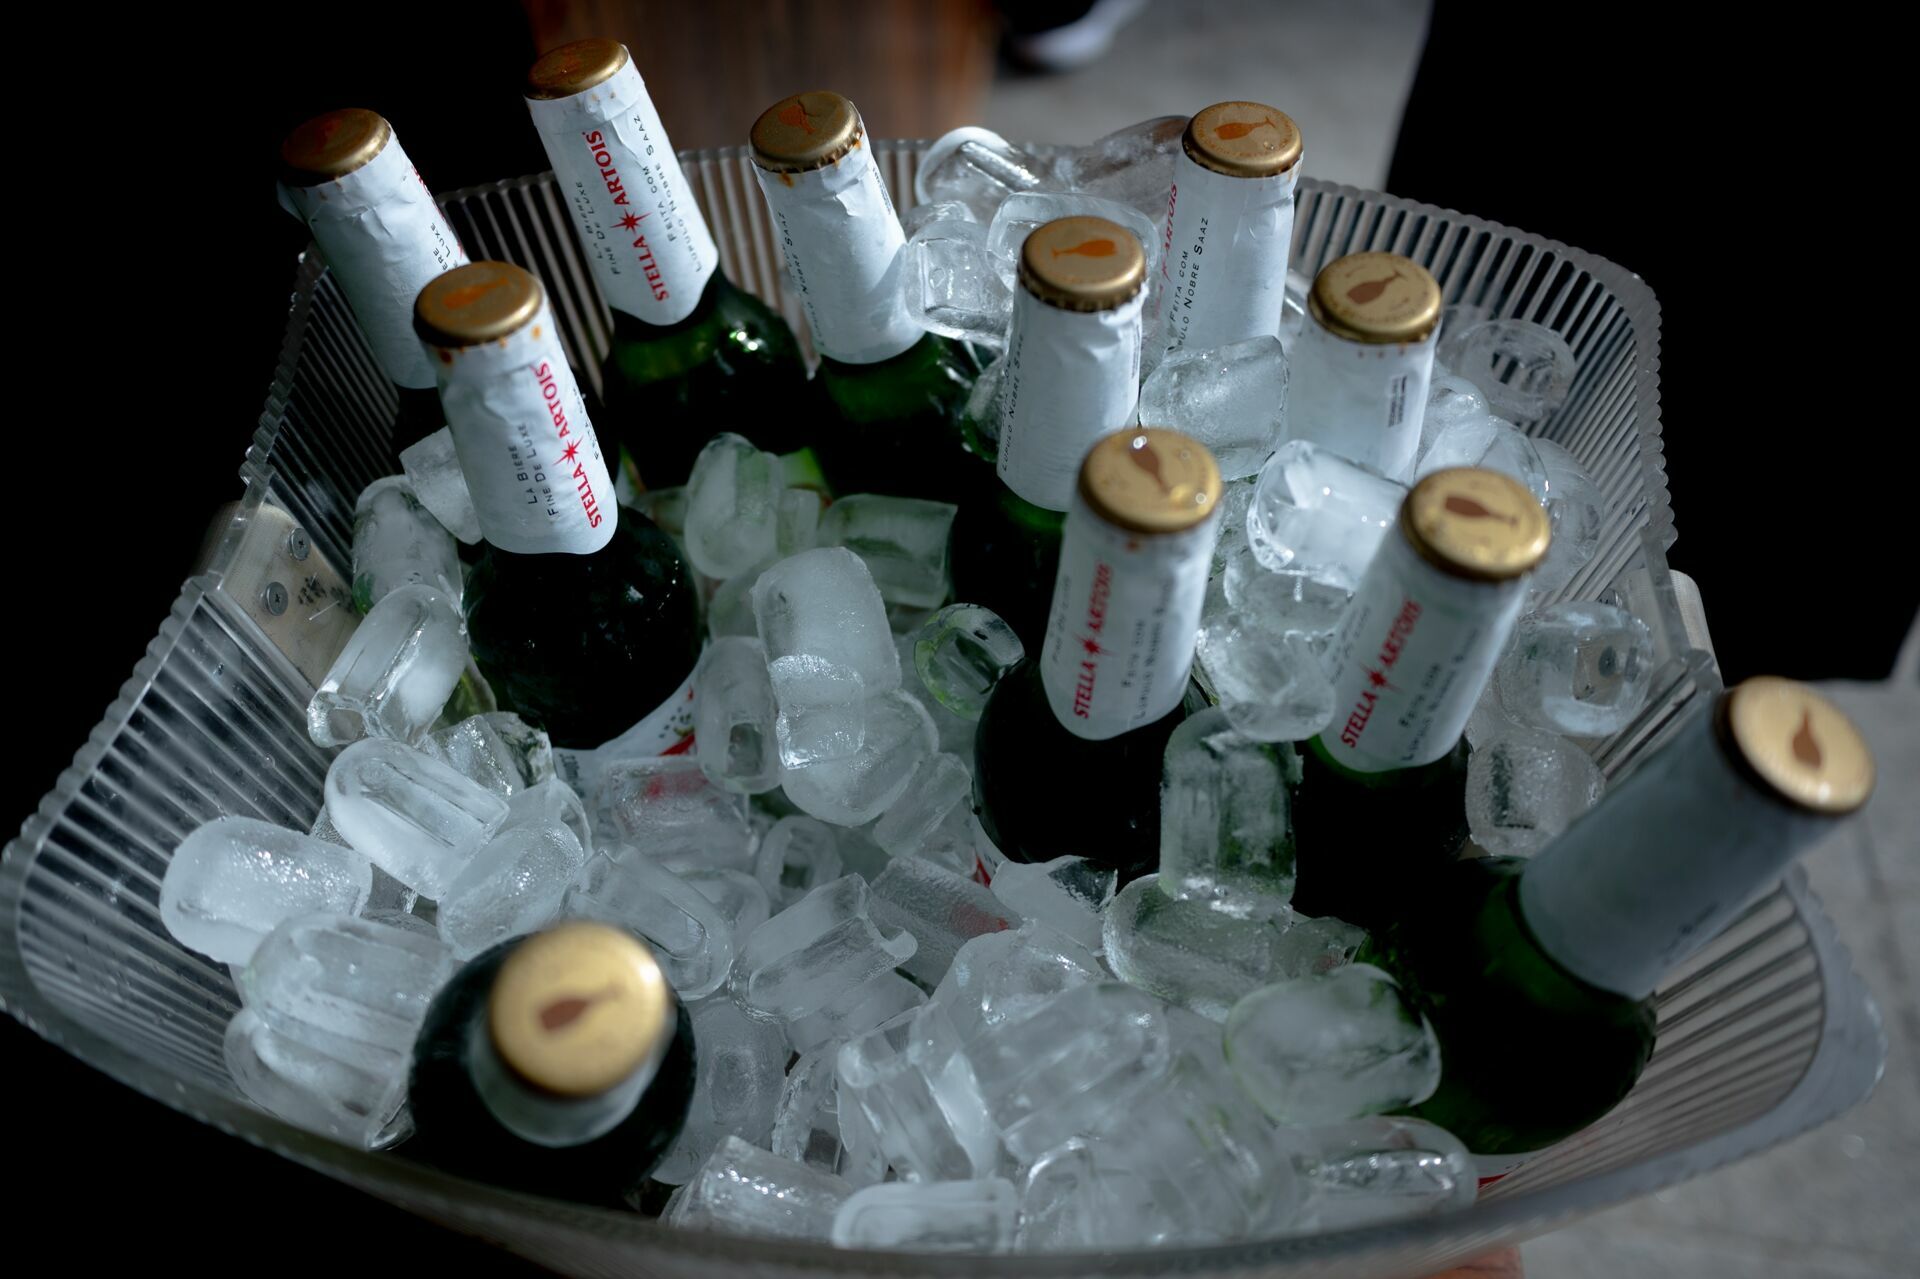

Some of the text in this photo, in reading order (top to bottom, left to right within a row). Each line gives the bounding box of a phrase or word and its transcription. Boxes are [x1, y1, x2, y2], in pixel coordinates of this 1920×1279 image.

[633, 114, 656, 157] SAAZ
[430, 222, 451, 258] LUXE
[576, 181, 622, 276] FINE DE LUXE
[583, 129, 670, 302] STELLA ARTOIS
[642, 165, 678, 243] FEITA COM
[432, 247, 449, 271] ERE
[1169, 250, 1190, 323] FEITA COM
[1183, 264, 1201, 309] NOBRE
[1193, 217, 1209, 256] SAAZ
[508, 443, 539, 505] LA BIERE
[517, 420, 560, 516] FINE DE LUXE
[535, 361, 603, 529] STELLA ARTOIS
[1072, 563, 1113, 720] STELLA ARTOIS
[1340, 690, 1379, 749] STELLA
